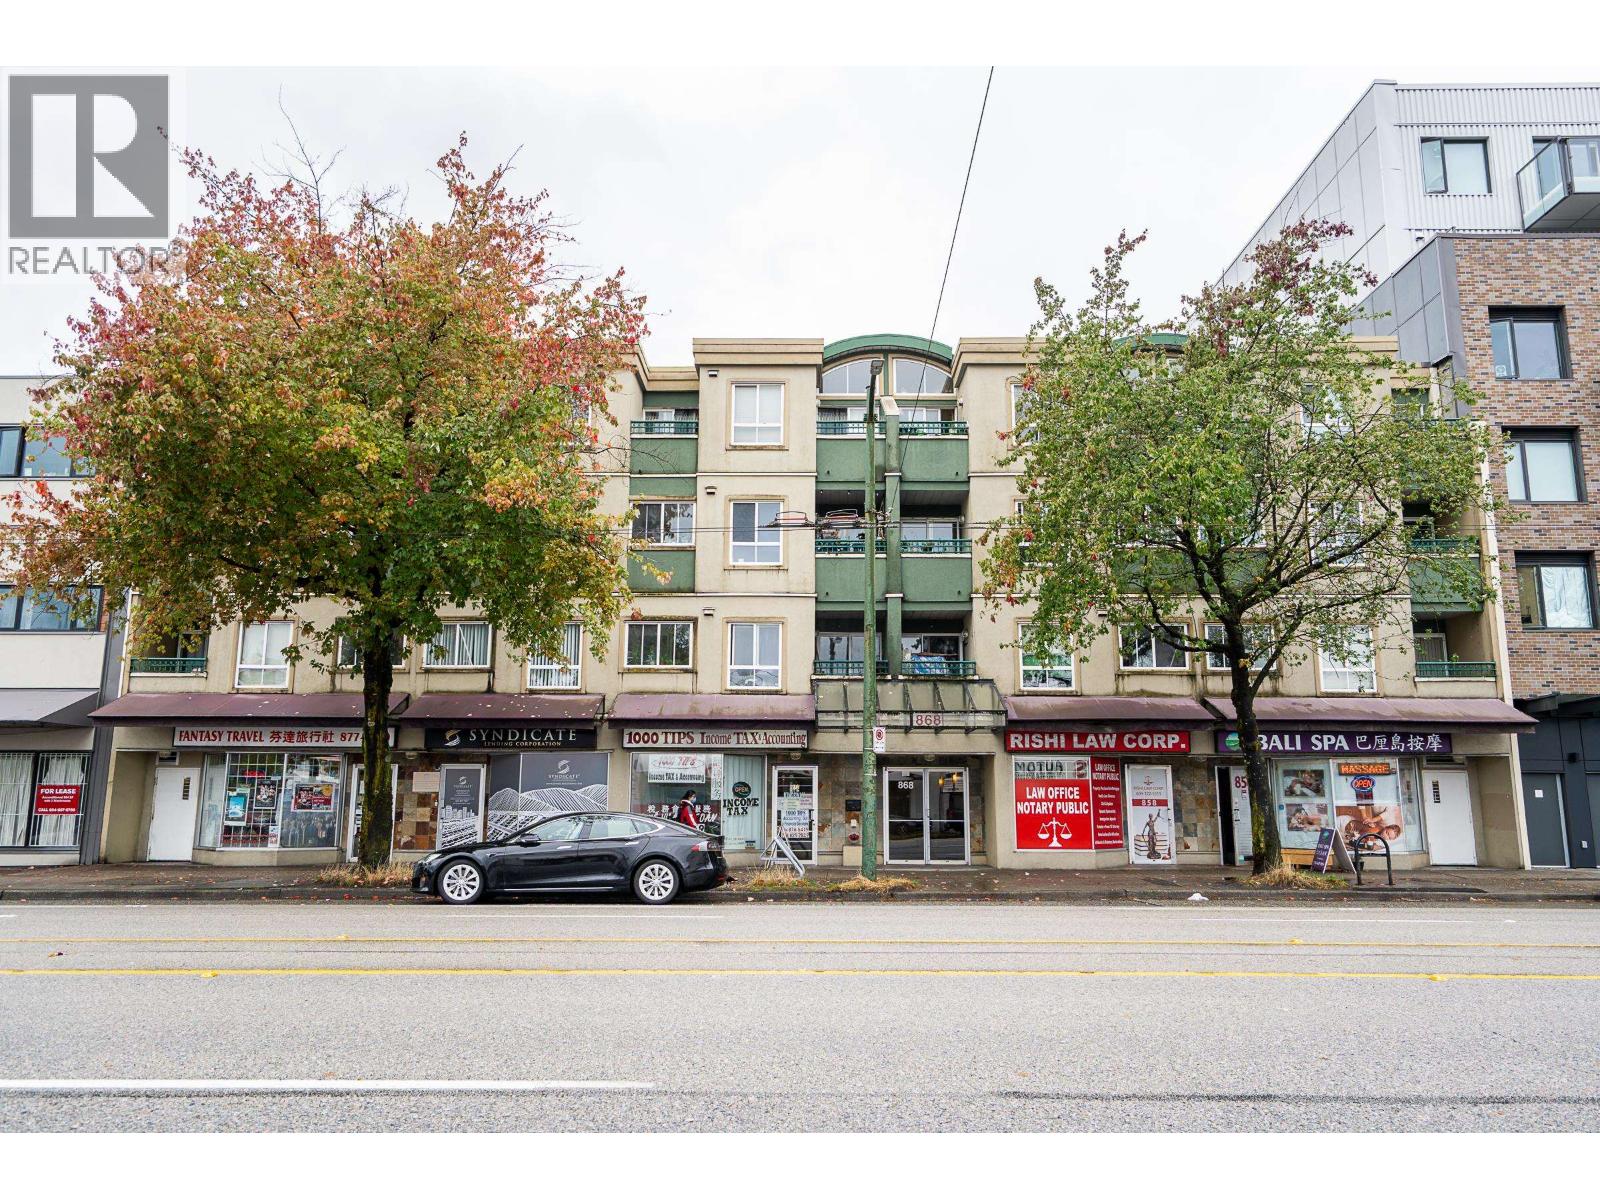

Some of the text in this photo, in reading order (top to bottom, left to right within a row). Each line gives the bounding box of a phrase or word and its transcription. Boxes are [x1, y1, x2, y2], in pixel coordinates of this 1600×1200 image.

[916, 715, 941, 726] 868
[178, 730, 264, 742] FANTASY TRAVEL
[269, 730, 334, 743] 芬達旅行社
[469, 729, 577, 741] SYNDICATE
[625, 731, 658, 744] 1000
[661, 731, 695, 744] TIPS
[700, 732, 732, 744] Income
[733, 732, 759, 744] TAX
[762, 732, 807, 747] Accounting
[1010, 733, 1186, 749] RISHI LAW CORP.
[1257, 735, 1350, 750] BALI SPA
[1355, 733, 1443, 751] 巴厘島按摩
[1341, 764, 1389, 774] MASSAGE
[897, 781, 914, 789] 868
[1235, 776, 1247, 788] 85
[1353, 779, 1373, 788] OPEN
[1026, 787, 1045, 799] LAW
[1048, 787, 1080, 799] OFFICE
[723, 797, 759, 808] INCOME
[1017, 801, 1054, 814] NOTARY
[1056, 801, 1089, 814] PUBLIC
[727, 807, 748, 816] TAX
